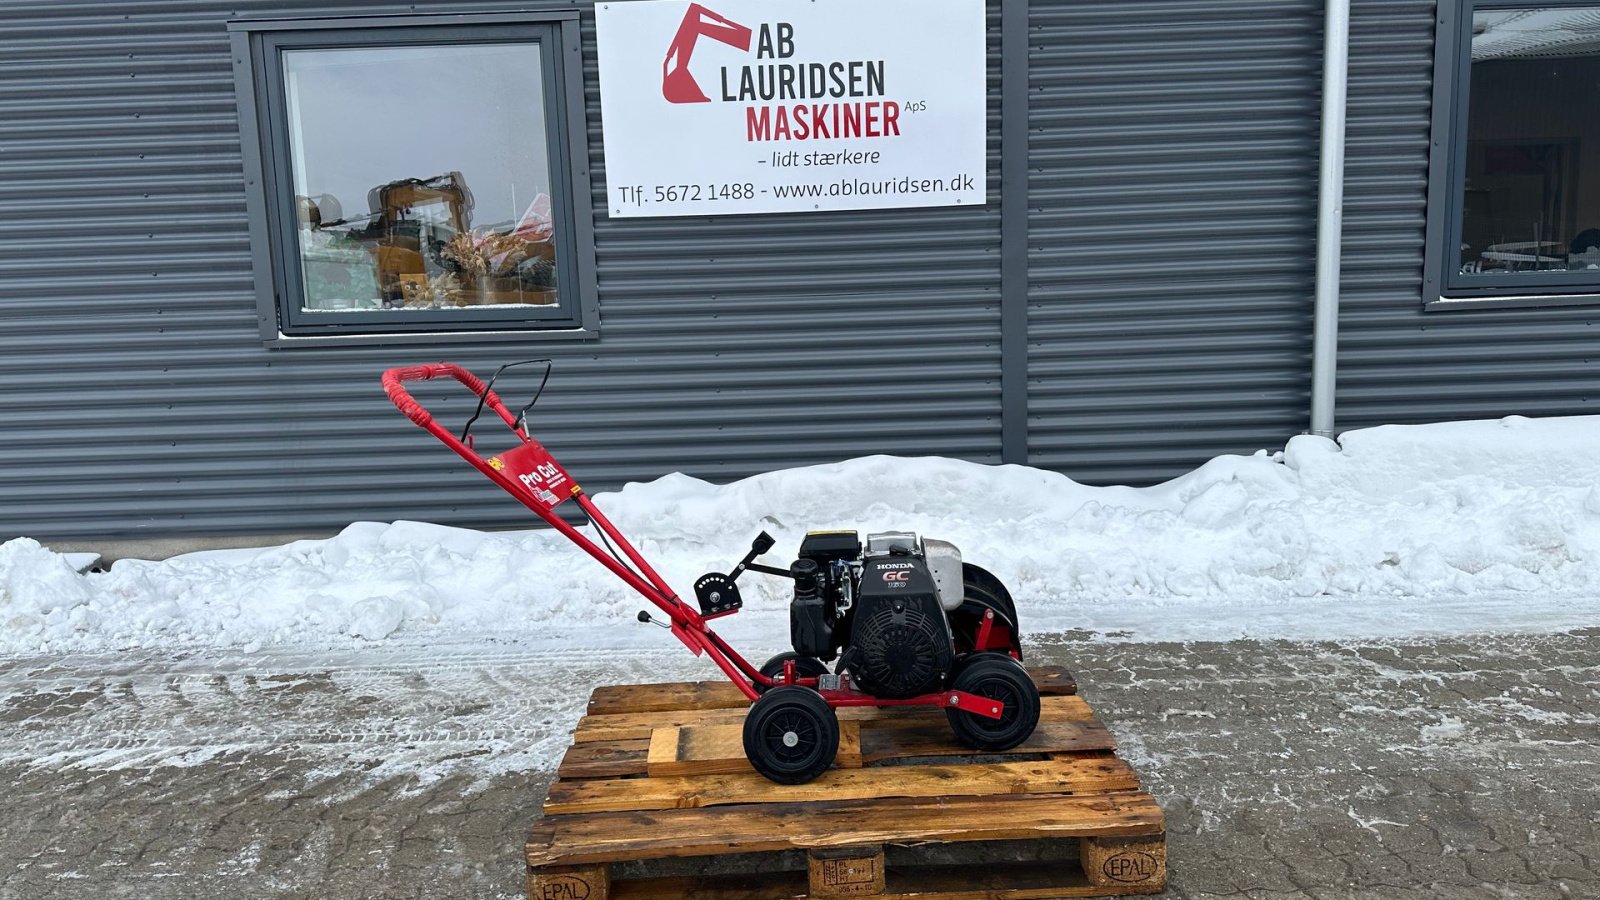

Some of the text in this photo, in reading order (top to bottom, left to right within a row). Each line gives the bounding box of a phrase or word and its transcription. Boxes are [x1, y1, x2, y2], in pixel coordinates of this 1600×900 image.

[757, 22, 795, 60] AB
[721, 60, 885, 102] LAURIDSEN
[746, 100, 927, 142] MASKINER ApS
[772, 151, 799, 168] lidt
[803, 149, 881, 167] stærkere
[618, 185, 649, 207] Tlf.
[655, 184, 702, 202] 5672
[708, 182, 755, 201] 1488
[773, 173, 975, 199] www.ablauridsen.dk
[518, 472, 543, 490] Pro
[537, 461, 559, 478] Cut
[882, 570, 910, 581] GC
[1111, 858, 1151, 876] EPAL
[543, 883, 583, 900] EPAL
